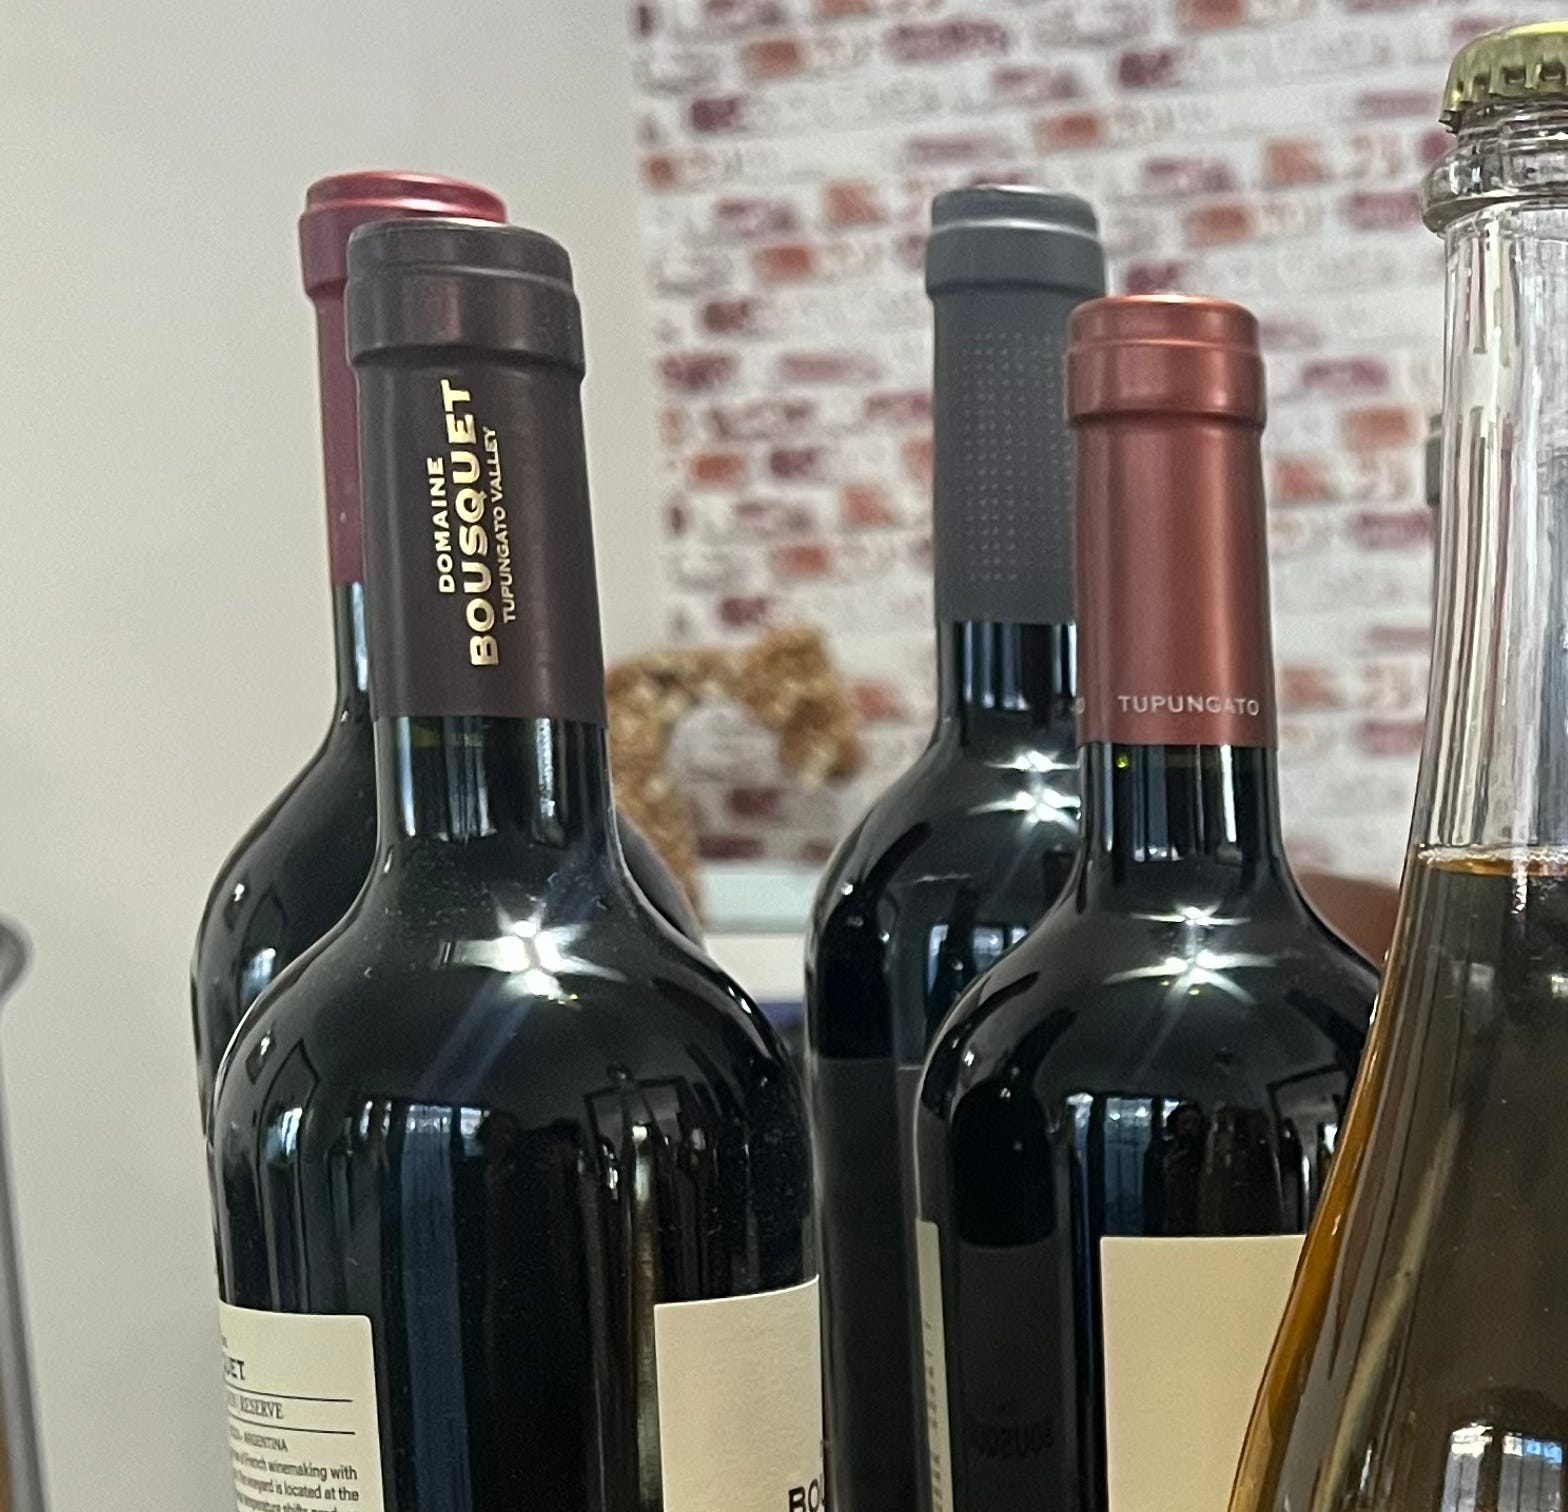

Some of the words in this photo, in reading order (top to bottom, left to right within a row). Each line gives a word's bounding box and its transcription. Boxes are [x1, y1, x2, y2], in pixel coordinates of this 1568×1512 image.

[482, 426, 504, 503] VALLEY
[426, 456, 456, 593] DOMAINE
[440, 378, 499, 666] BOUSQUET
[493, 507, 516, 624] TUPUNGATO
[1117, 694, 1260, 717] TUPUNGATO
[268, 1460, 328, 1482] winemaking
[330, 1464, 358, 1481] with
[284, 1479, 322, 1500] located
[324, 1487, 336, 1500] at
[339, 1486, 360, 1502] the
